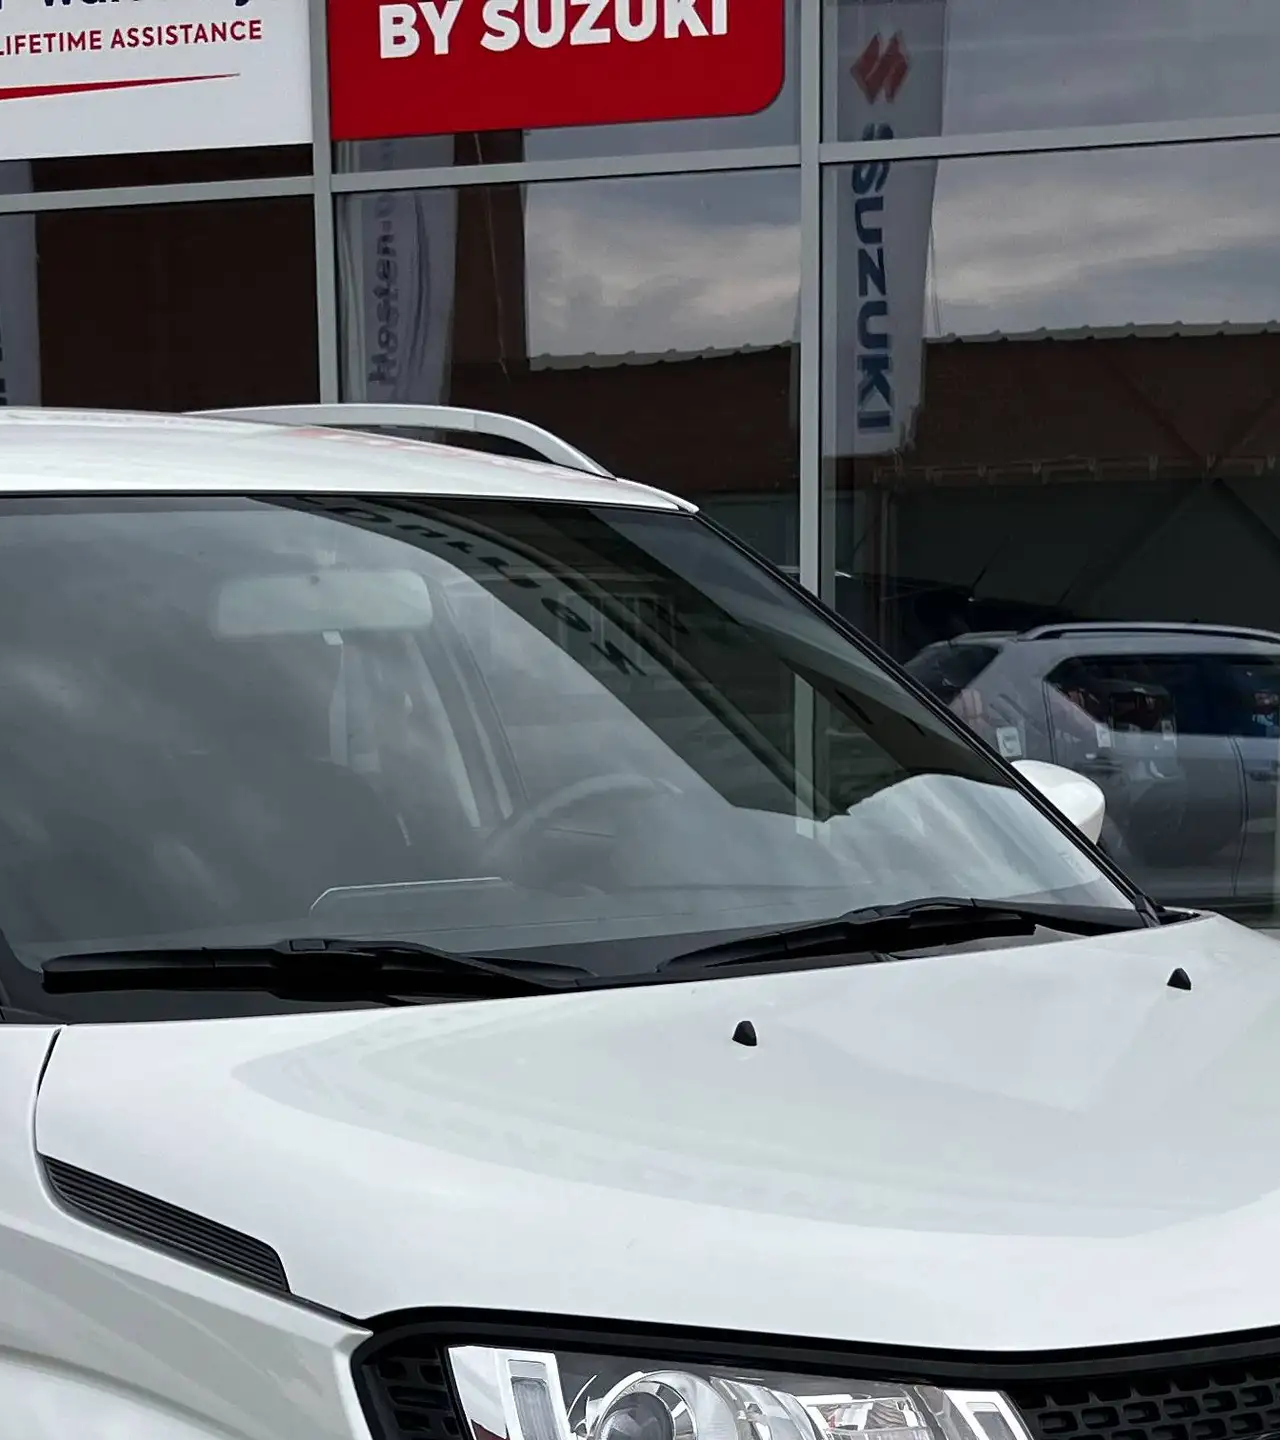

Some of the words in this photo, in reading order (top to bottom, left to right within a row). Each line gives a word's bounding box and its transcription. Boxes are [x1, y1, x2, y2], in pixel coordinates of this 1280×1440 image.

[110, 19, 262, 49] ASSISTANCE
[378, 1, 462, 59] BY
[480, 0, 729, 52] SUZUKI
[851, 122, 894, 434] SUZUKI
